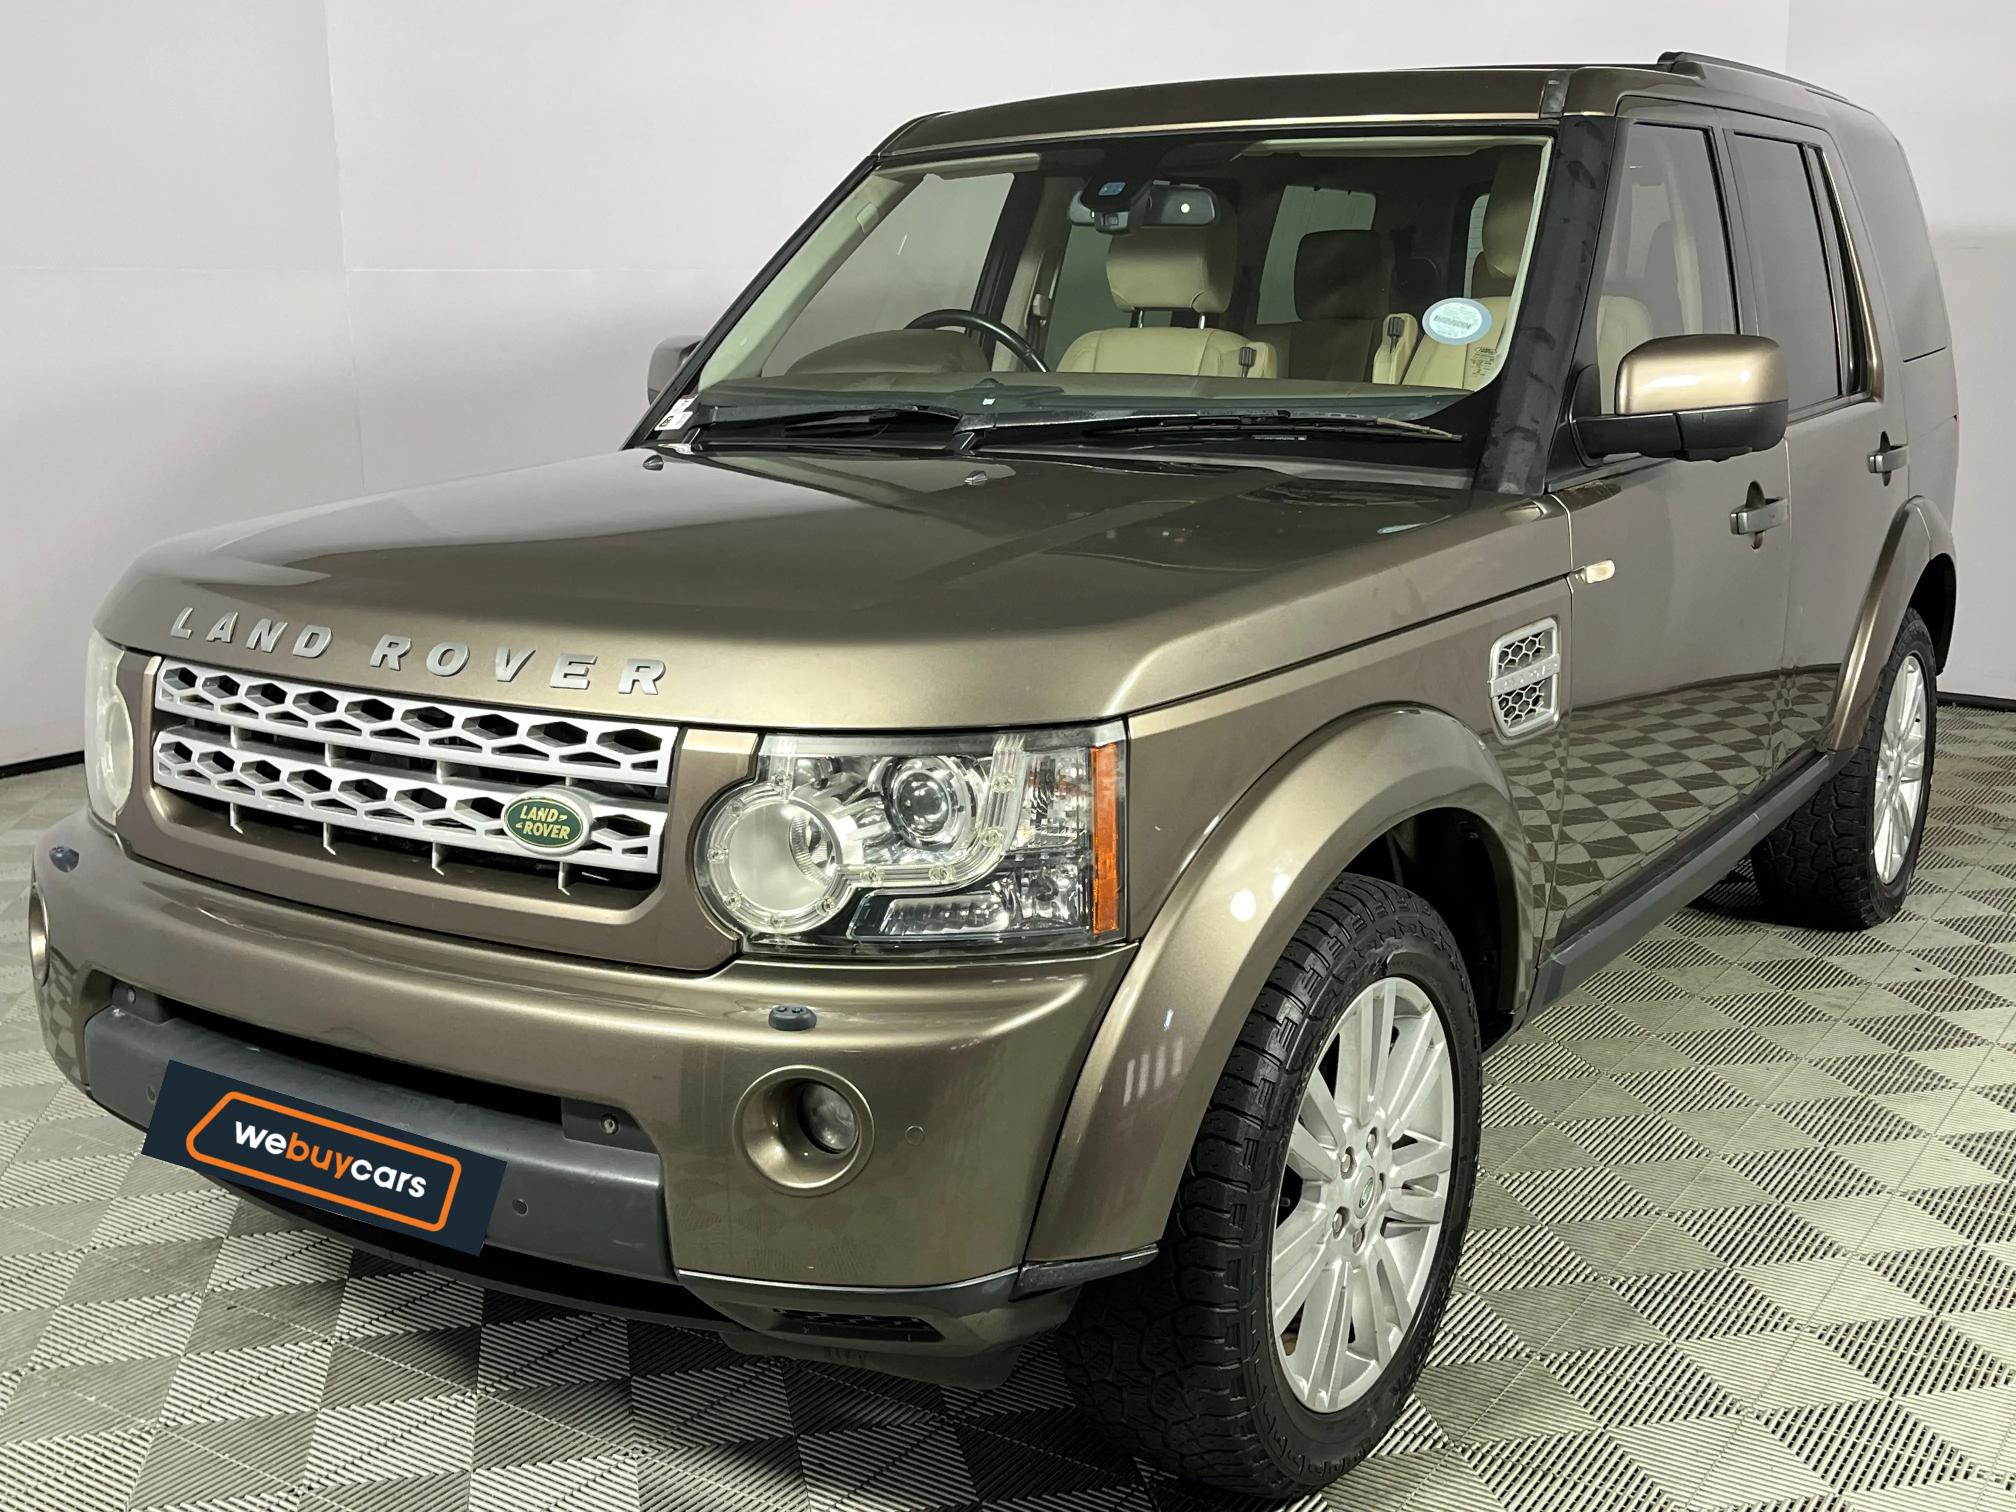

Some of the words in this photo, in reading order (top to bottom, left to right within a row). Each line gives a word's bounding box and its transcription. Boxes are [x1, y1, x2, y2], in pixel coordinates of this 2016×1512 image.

[170, 607, 333, 659] LAND
[369, 633, 667, 696] ROVER
[520, 805, 559, 823] LAND
[523, 821, 571, 840] ROVER
